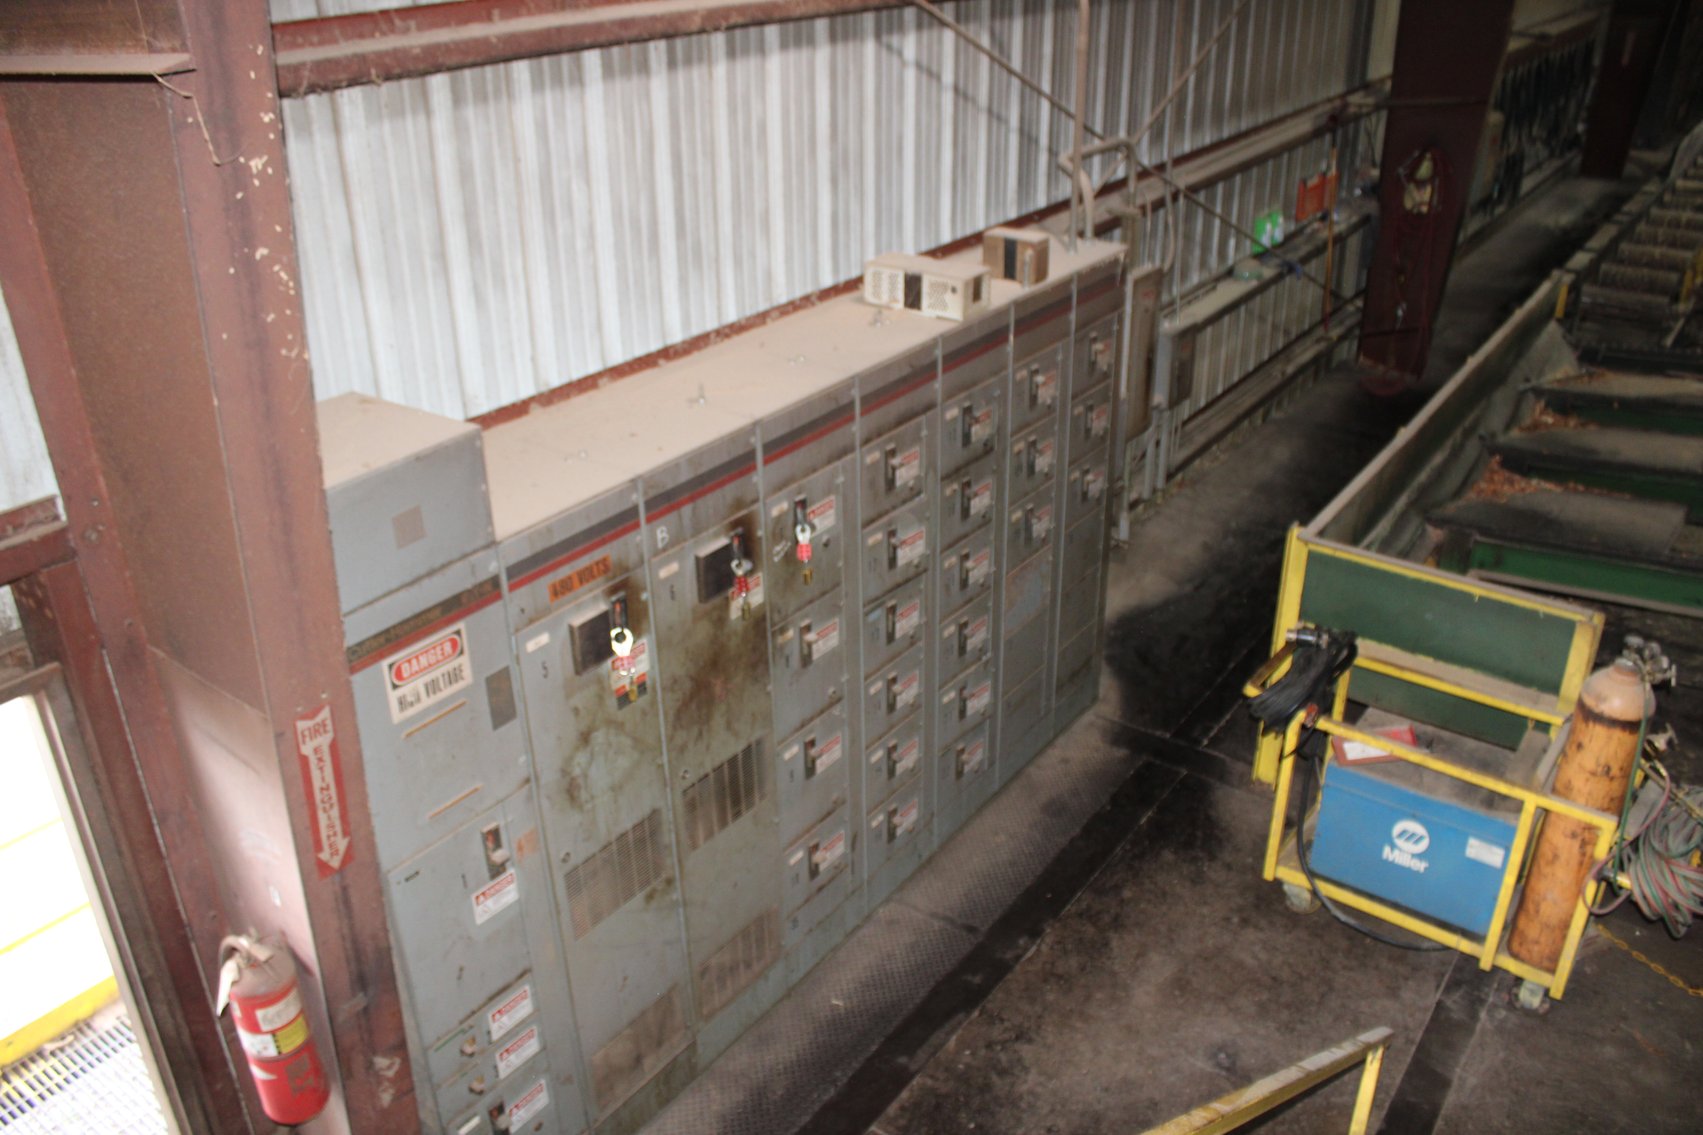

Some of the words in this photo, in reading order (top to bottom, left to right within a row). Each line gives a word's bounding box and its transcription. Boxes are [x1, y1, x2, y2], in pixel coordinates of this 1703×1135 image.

[401, 640, 453, 679] DANGER
[424, 664, 465, 699] VOLTAGE
[301, 718, 330, 744] FIRE
[314, 745, 340, 858] EXTINGUISHER
[1382, 844, 1429, 873] Miller
